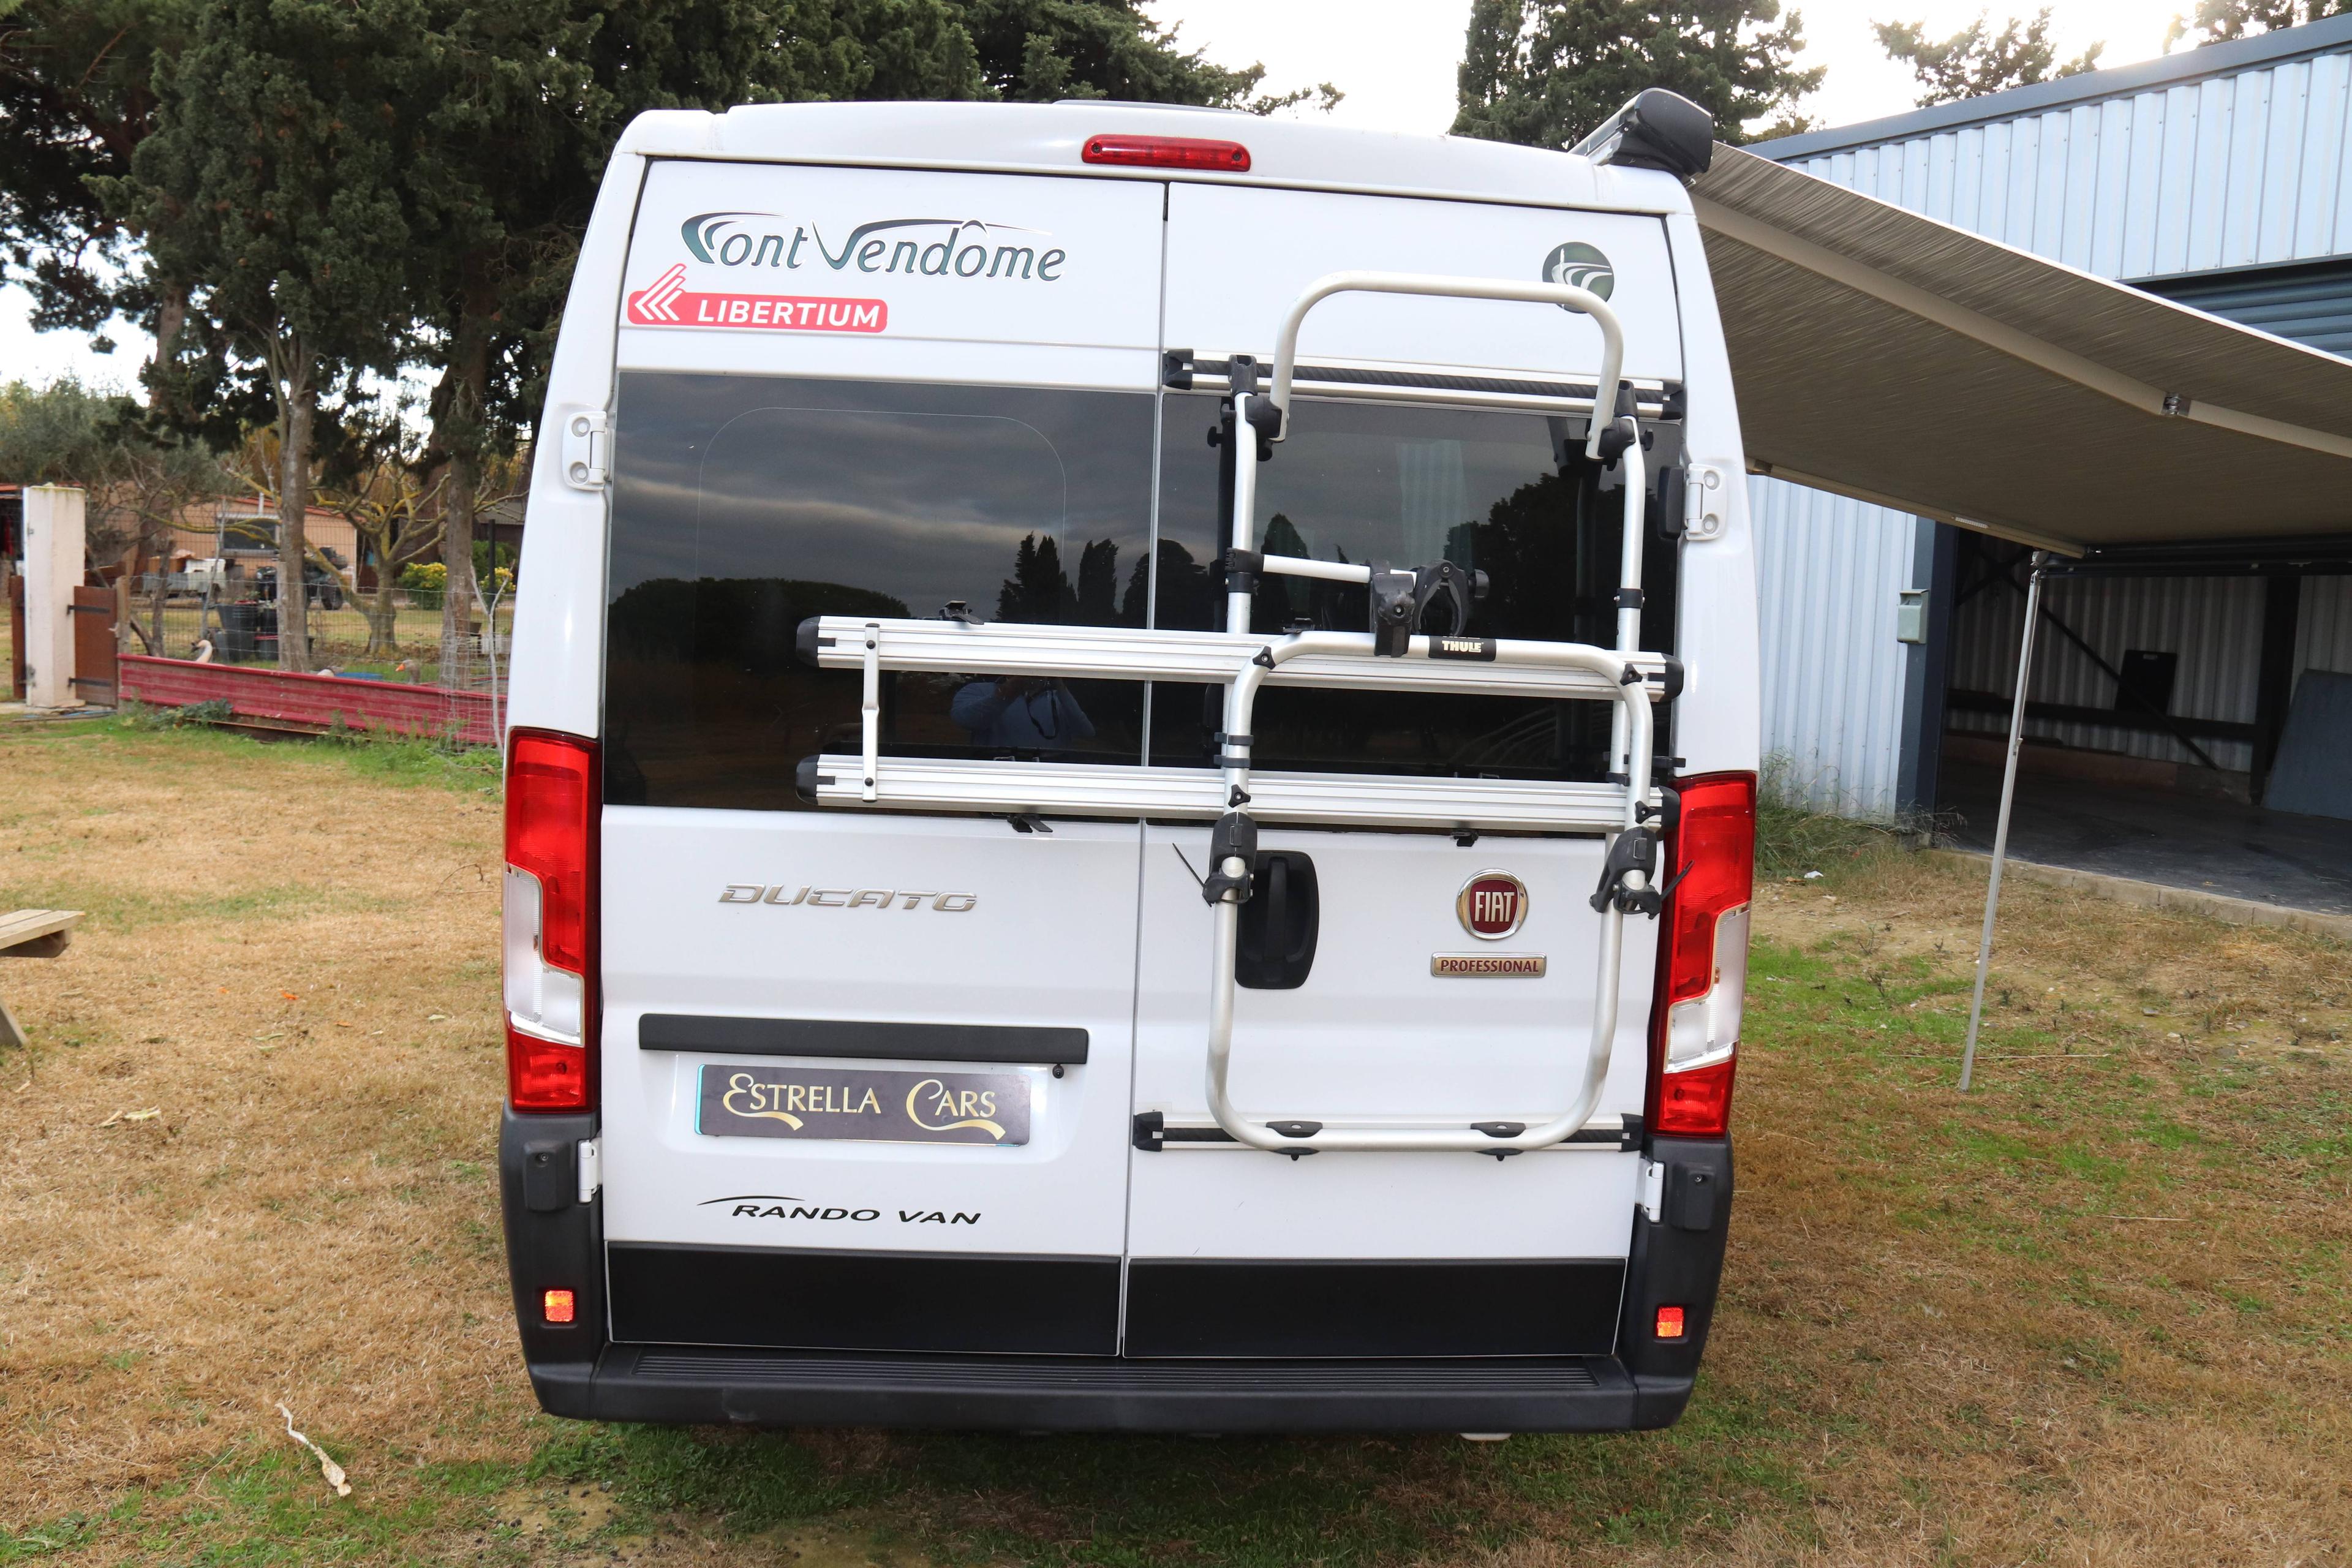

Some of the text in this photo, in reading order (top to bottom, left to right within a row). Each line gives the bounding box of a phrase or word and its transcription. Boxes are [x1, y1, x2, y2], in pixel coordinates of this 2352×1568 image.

[697, 300, 880, 328] LIBERTIUM
[1442, 641, 1481, 653] THULE
[718, 883, 978, 912] DUCATO
[1474, 891, 1515, 922] FIAT
[1440, 960, 1539, 973] PROFESSIONAL
[731, 1205, 981, 1225] RANDO VAN
